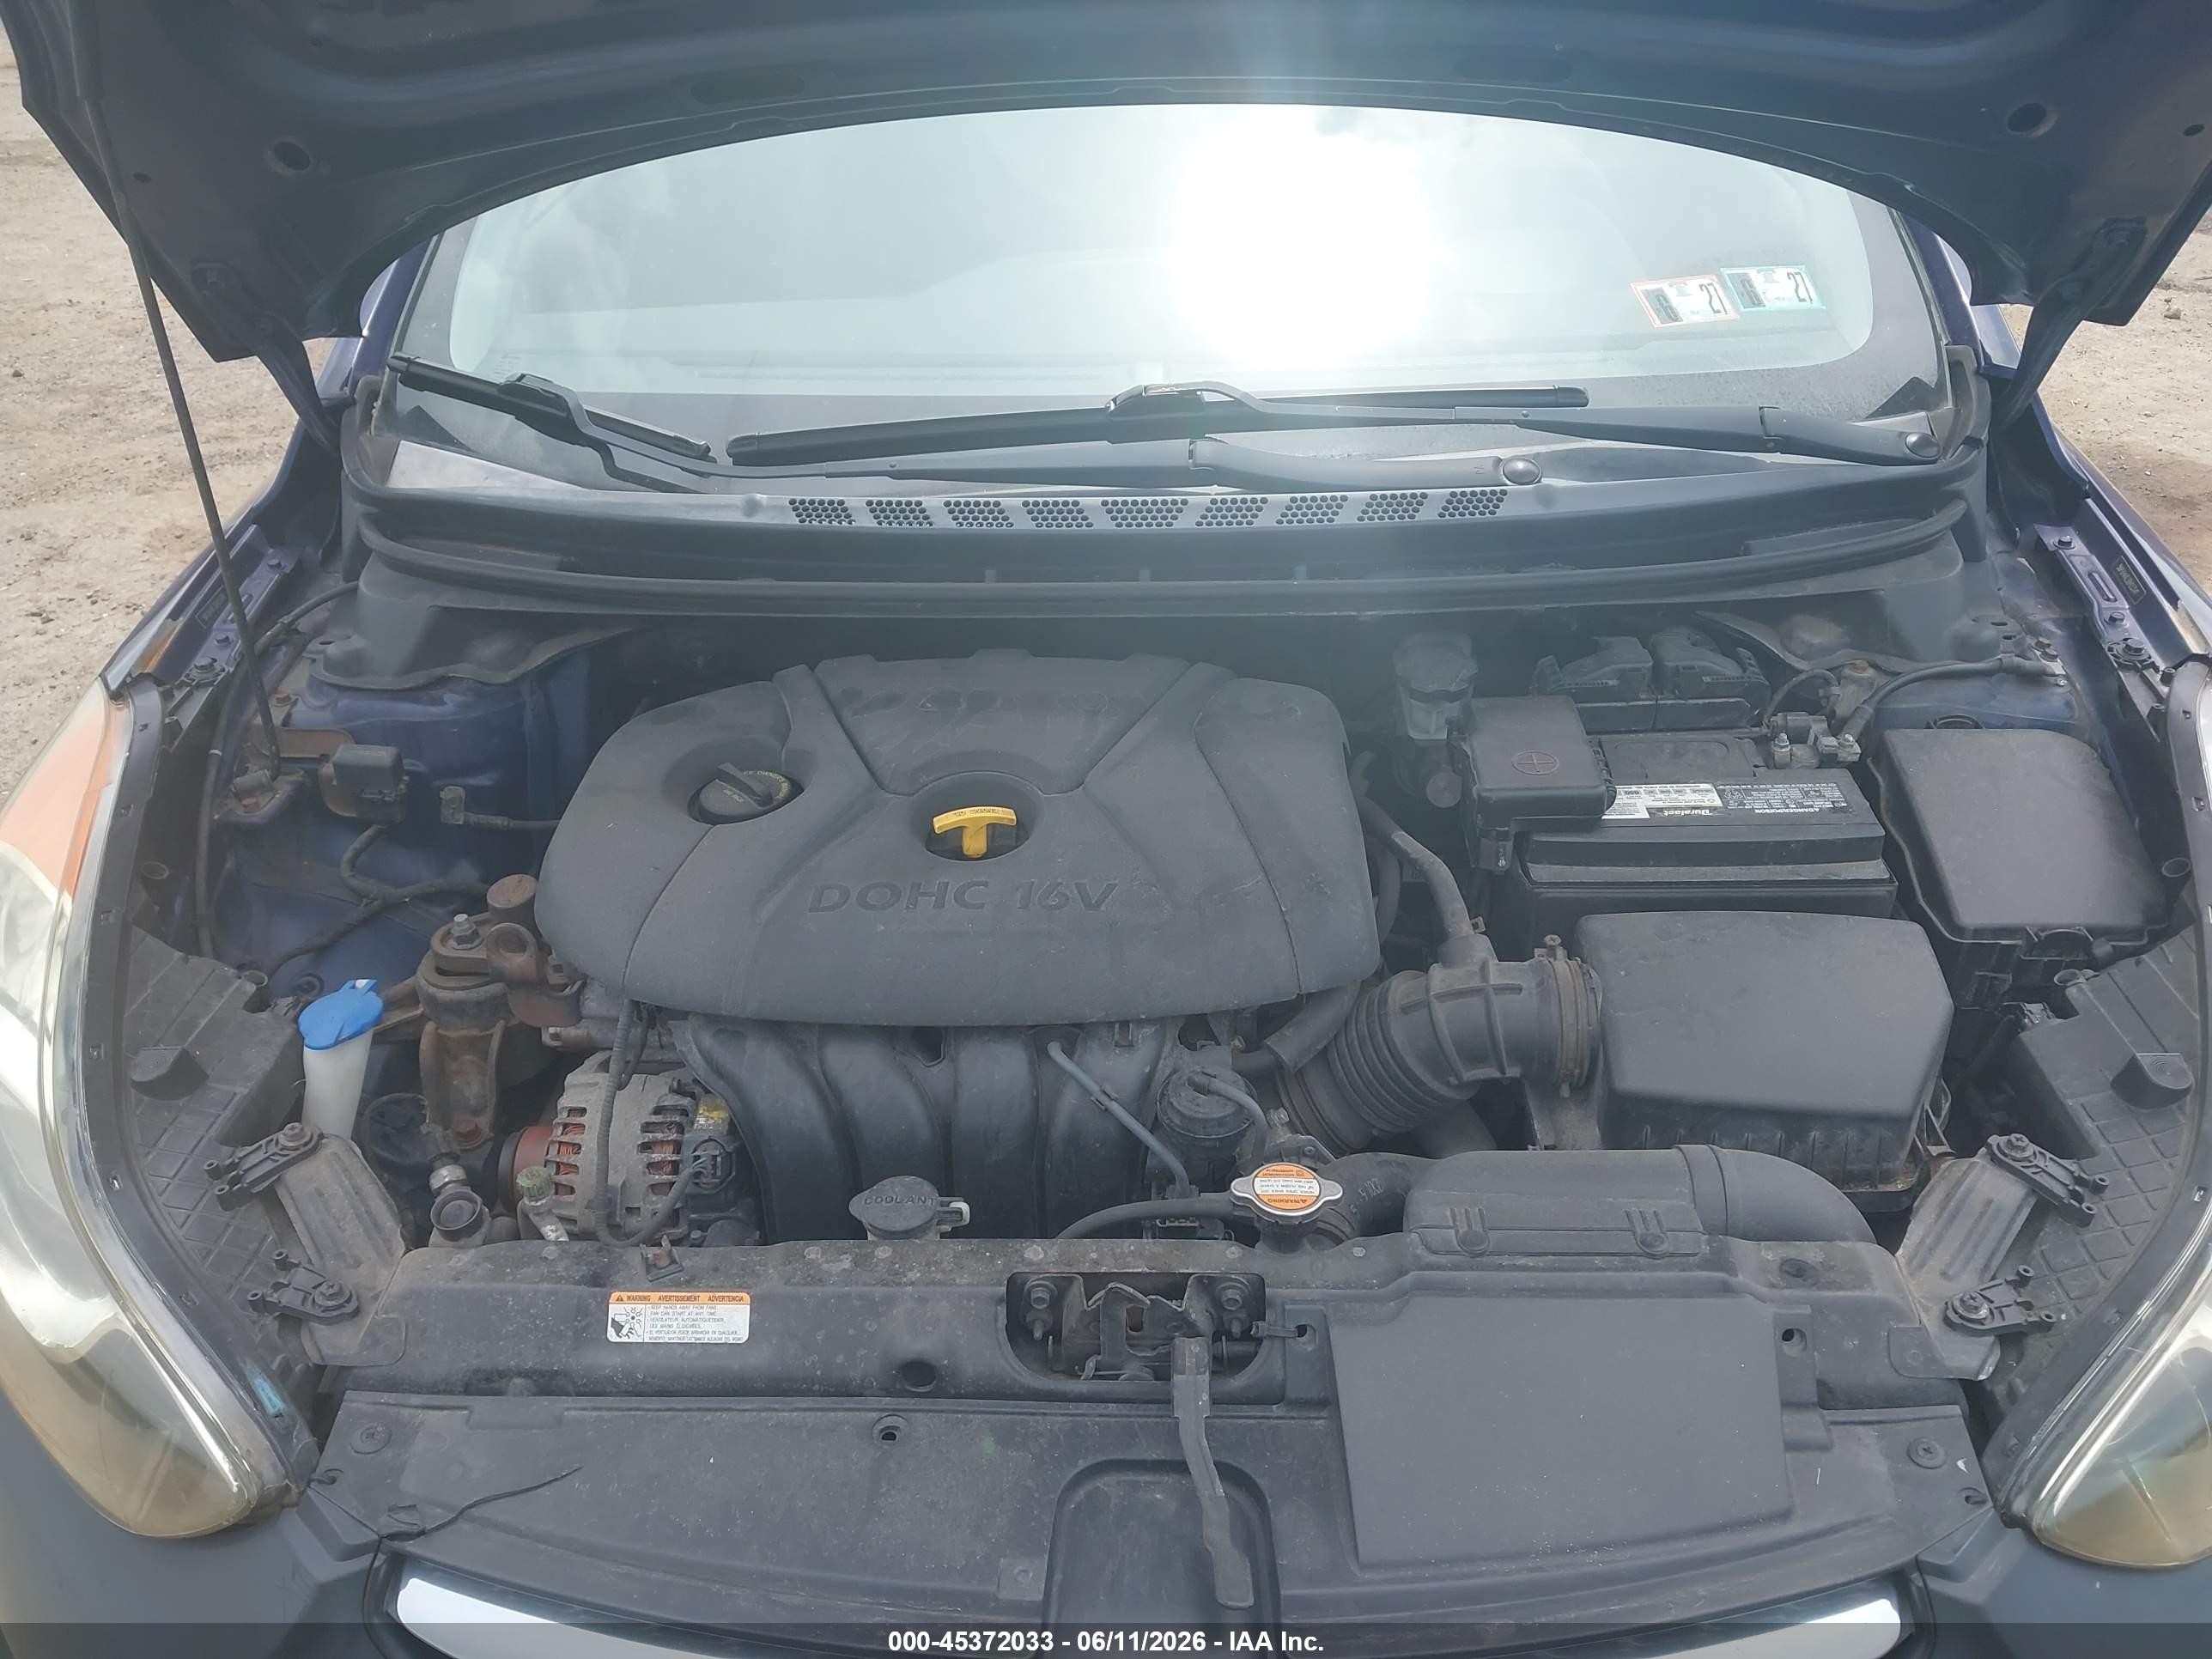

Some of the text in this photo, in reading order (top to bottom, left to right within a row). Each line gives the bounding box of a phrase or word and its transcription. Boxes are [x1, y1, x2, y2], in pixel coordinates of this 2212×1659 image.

[1698, 282, 1728, 315] 27
[1786, 271, 1813, 304] 27
[807, 878, 1118, 913] DOHC 16V
[864, 1194, 935, 1206] COOLANT
